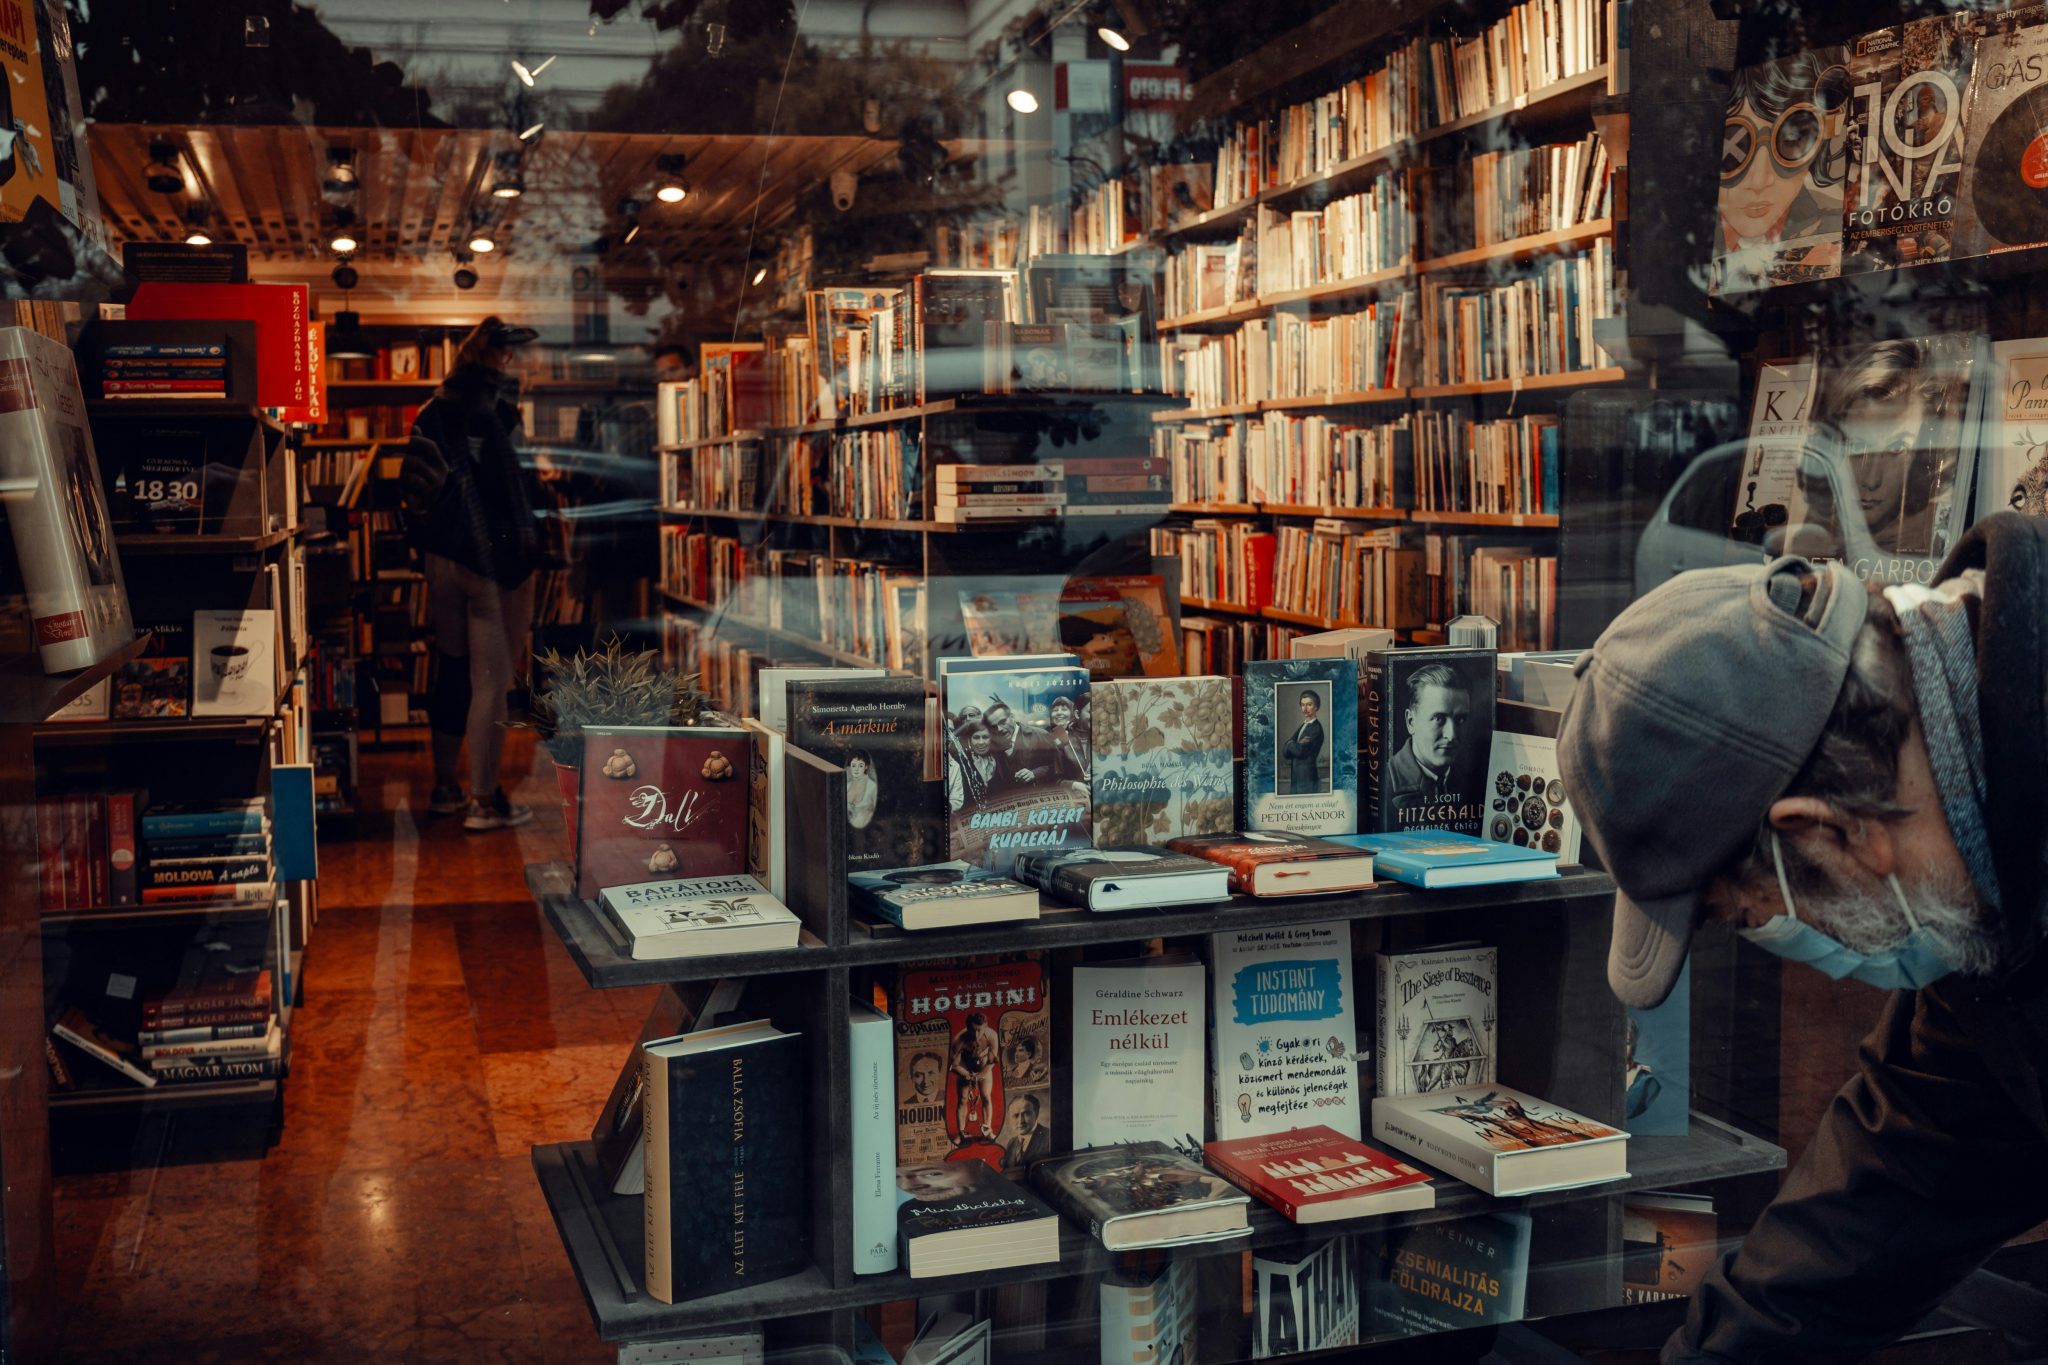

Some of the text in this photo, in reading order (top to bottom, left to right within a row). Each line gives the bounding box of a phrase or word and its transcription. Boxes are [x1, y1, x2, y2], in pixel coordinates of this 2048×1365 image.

[1867, 37, 1892, 48] NATIONAL
[1867, 40, 1900, 52] GEOGRAPHIC
[1986, 53, 2048, 89] GAS
[1853, 70, 1970, 164] 10
[1849, 195, 1952, 227] FOTÓKRÓ
[1850, 232, 1861, 240] AZ
[1854, 558, 1935, 584] GARBO
[1046, 677, 1083, 687] JÓZSEF
[812, 701, 907, 714] Simonetta Agnello Hornby
[820, 716, 898, 736] A márkiné
[1368, 690, 1380, 811] FITZGERALD
[1102, 776, 1167, 792] Philosophie
[1268, 802, 1284, 810] Nem
[1434, 793, 1461, 804] SCOTT
[970, 810, 1023, 830] BAMBI,
[1261, 808, 1346, 823] PETŐFI SÁNDOR
[1398, 803, 1485, 823] FITZGERALD
[988, 825, 1067, 850] KUPLERÁJ
[153, 870, 215, 884] MOLDOVA
[218, 869, 229, 883] A
[644, 885, 757, 902] FILODENDRON
[1237, 932, 1263, 943] Mitchell
[1294, 930, 1310, 940] Greg
[1311, 928, 1332, 937] Brown
[1256, 966, 1317, 993] INSTANT
[1400, 979, 1422, 1005] The
[1422, 971, 1444, 989] Siege
[1444, 967, 1453, 981] of
[1454, 967, 1492, 997] Beszterce
[910, 986, 1037, 1015] HOUDINI
[1095, 989, 1184, 999] Géraldine Schwarz
[1250, 989, 1326, 1016] TUDOMÁNY
[1091, 1008, 1189, 1026] Emlékezet
[1109, 1032, 1169, 1050] nélkül
[1100, 1060, 1111, 1068] Egy
[1134, 1059, 1152, 1067] család
[1258, 1052, 1328, 1069] kínzó kérdések,
[163, 1061, 264, 1081] MAGYAR ATOM
[732, 1058, 744, 1095] BALLA
[1238, 1065, 1347, 1084] közismert mendemondák
[1256, 1079, 1349, 1098] és különös jelenségek
[1258, 1098, 1309, 1118] megfejtése
[733, 1171, 745, 1197] FELE
[874, 1151, 882, 1198] Elena Ferrante
[733, 1229, 745, 1256] ÉLET
[1435, 1224, 1496, 1259] WEINER
[870, 1247, 888, 1256] PARK
[734, 1260, 746, 1276] AZ
[1394, 1247, 1500, 1297] ZSENIALITÁS
[1388, 1268, 1485, 1316] FÖLDRAJZA
[1638, 1289, 1688, 1304] KARA
